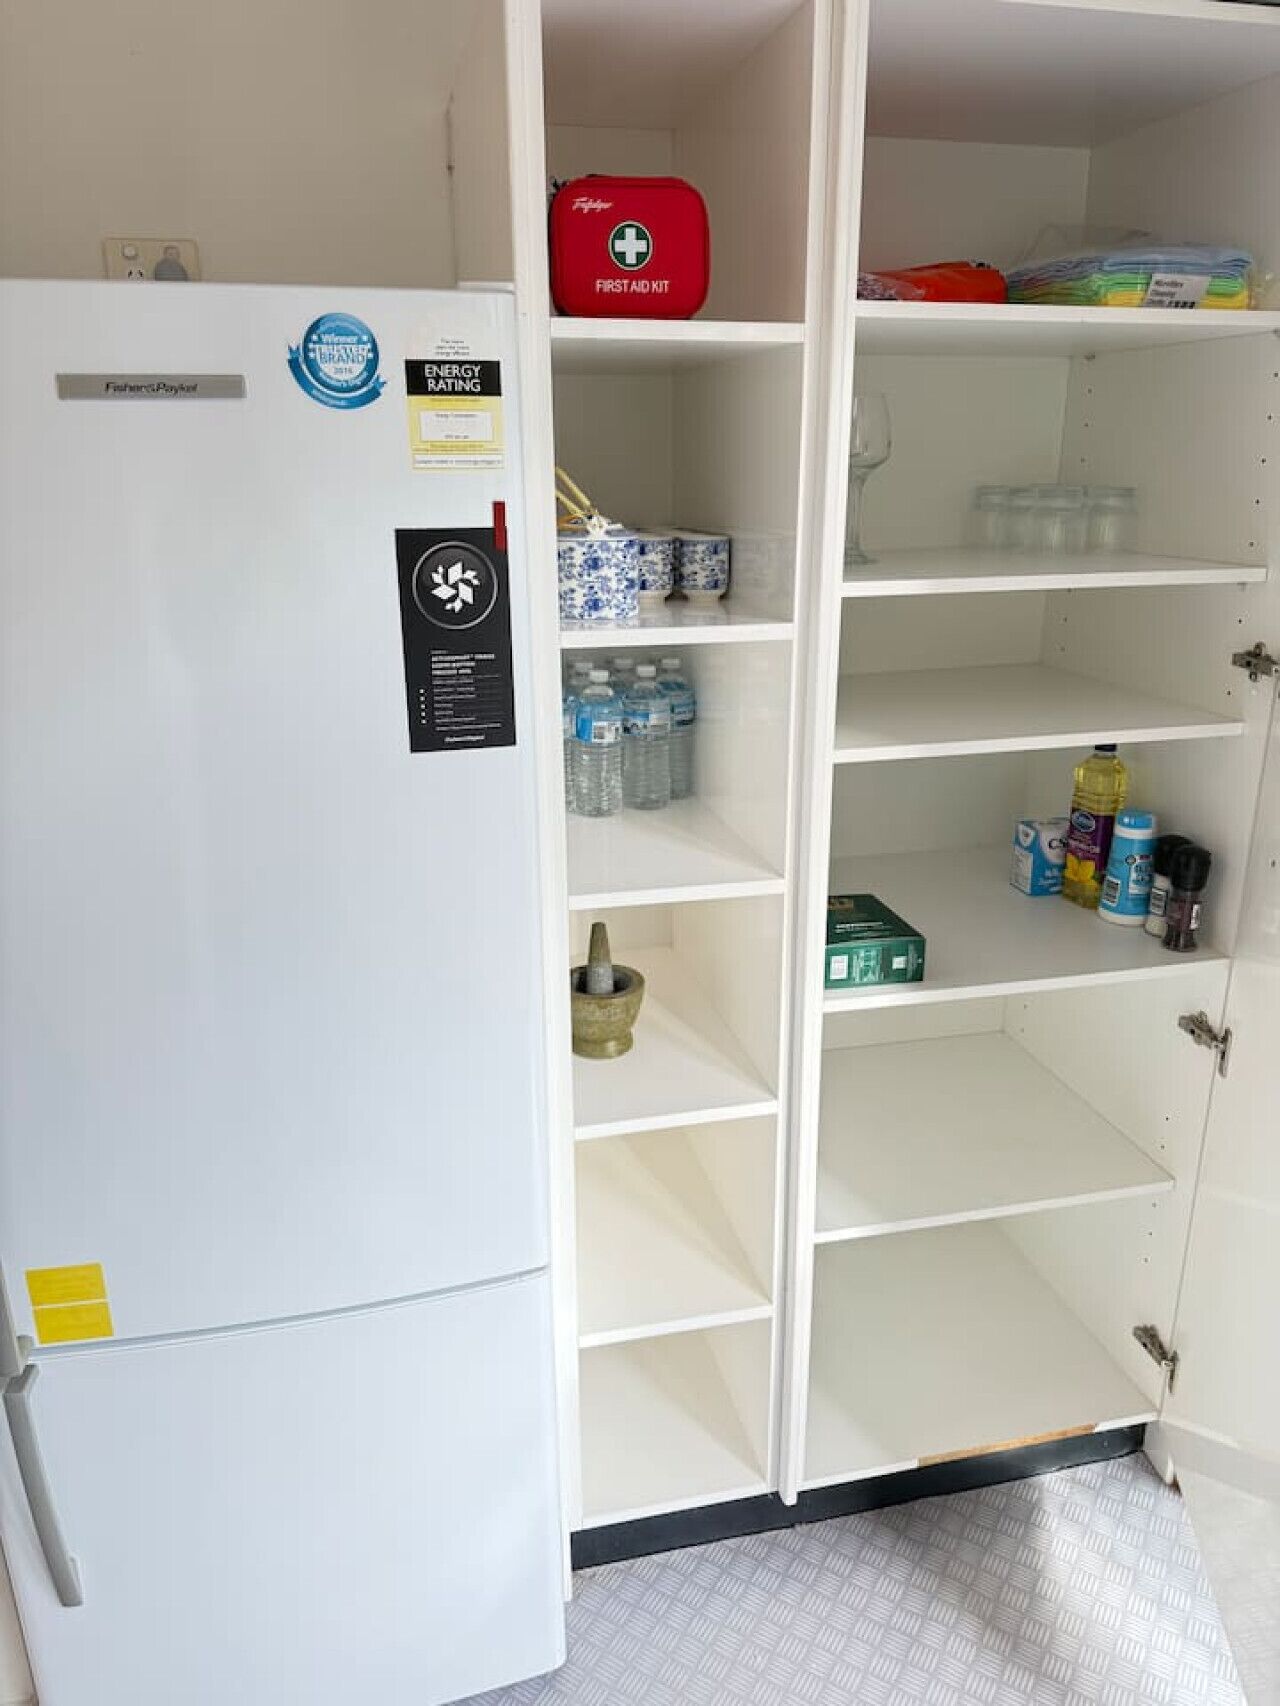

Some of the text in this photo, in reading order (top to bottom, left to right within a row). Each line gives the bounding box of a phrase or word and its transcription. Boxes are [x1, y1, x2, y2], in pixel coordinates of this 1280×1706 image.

[595, 279, 670, 293] FIRST AID KIT
[319, 352, 366, 364] BRAND
[424, 364, 481, 378] ENERGY
[428, 379, 481, 392] RATING
